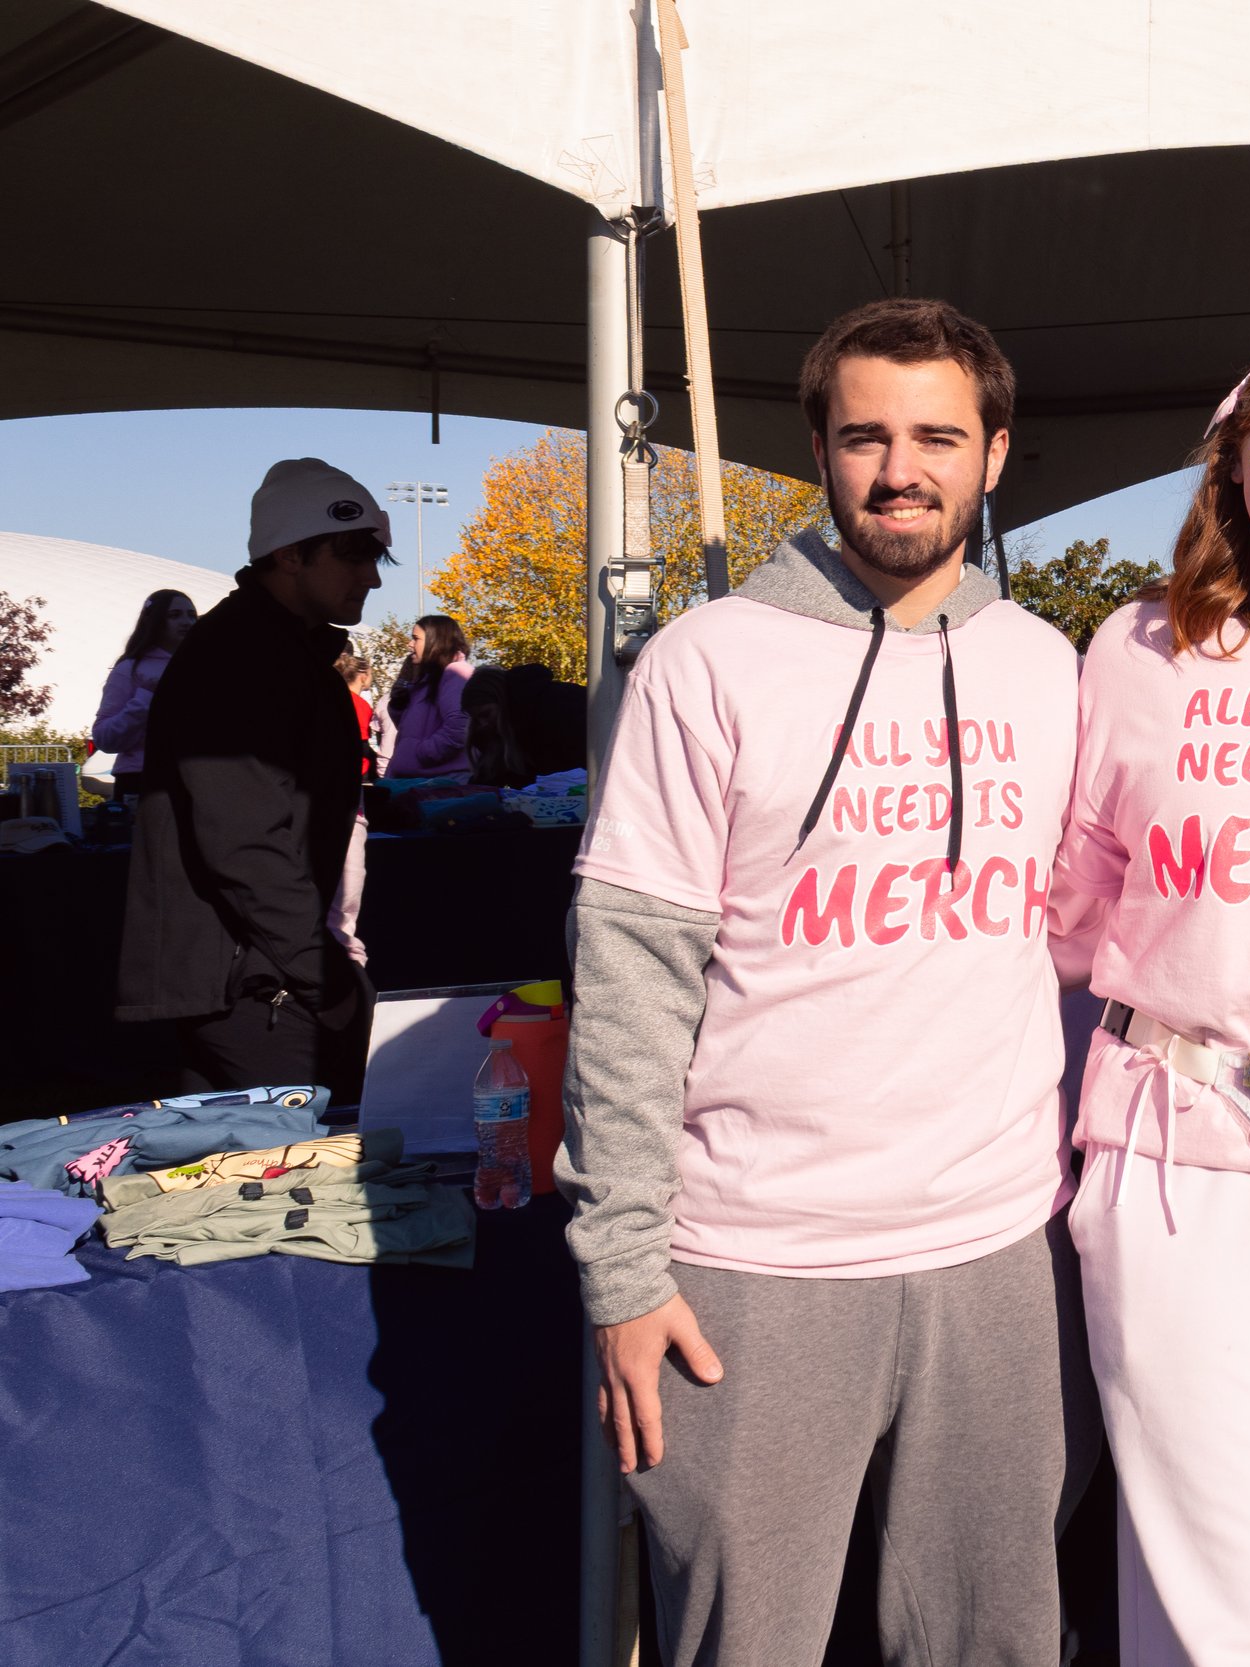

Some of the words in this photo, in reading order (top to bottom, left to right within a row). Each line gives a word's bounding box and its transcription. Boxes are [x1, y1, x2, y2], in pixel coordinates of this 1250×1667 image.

[923, 716, 1017, 768] YOU
[832, 783, 953, 837] NEED
[972, 778, 1023, 830] IS
[780, 855, 1050, 949] MERCH
